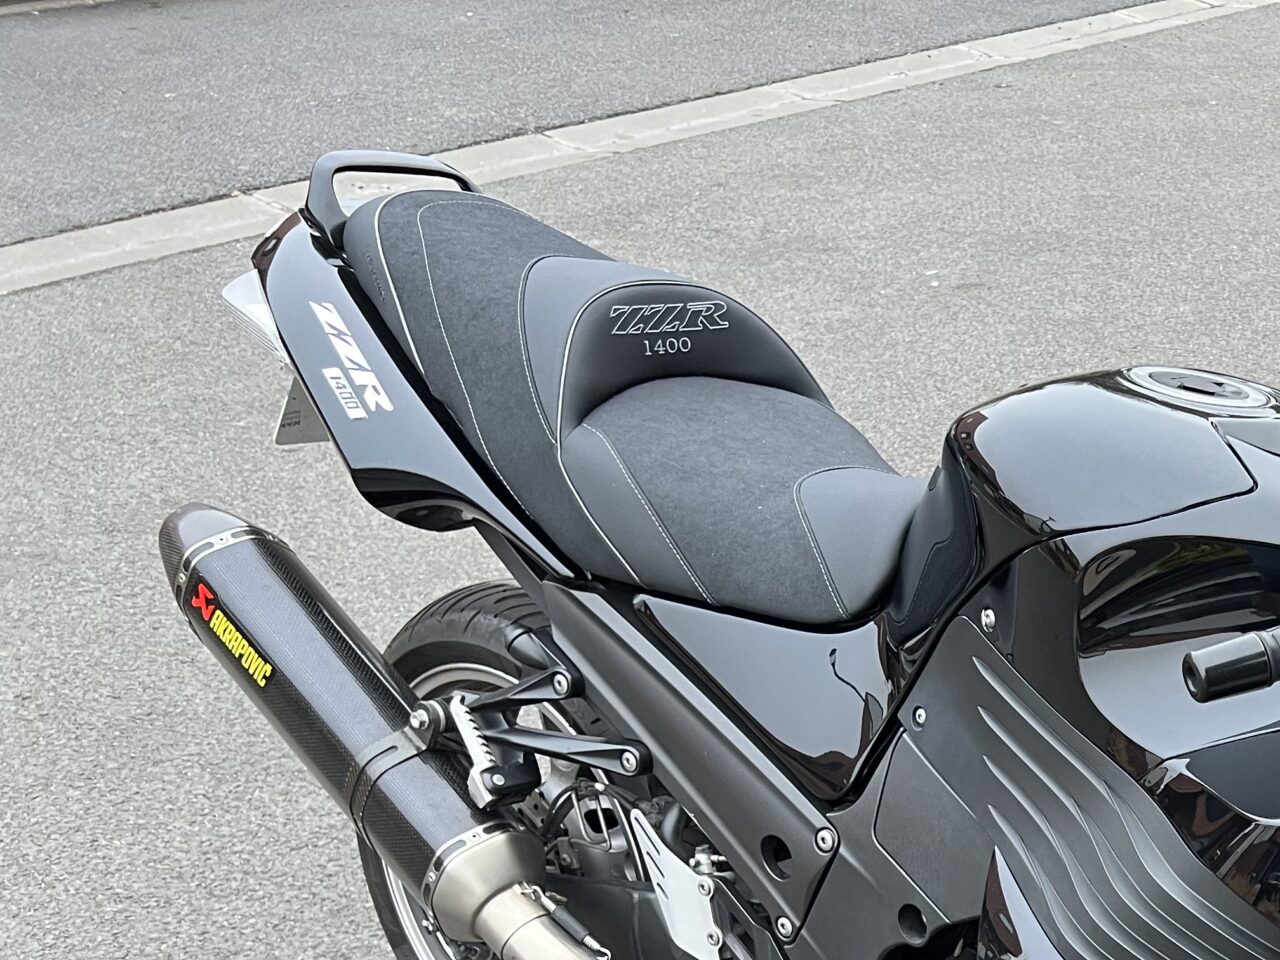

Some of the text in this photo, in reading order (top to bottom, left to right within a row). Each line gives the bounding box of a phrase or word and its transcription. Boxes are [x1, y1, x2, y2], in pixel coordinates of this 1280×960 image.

[609, 300, 730, 335] ZZR
[307, 300, 395, 412] ZZR
[643, 337, 692, 356] 1400
[327, 374, 362, 412] 1400
